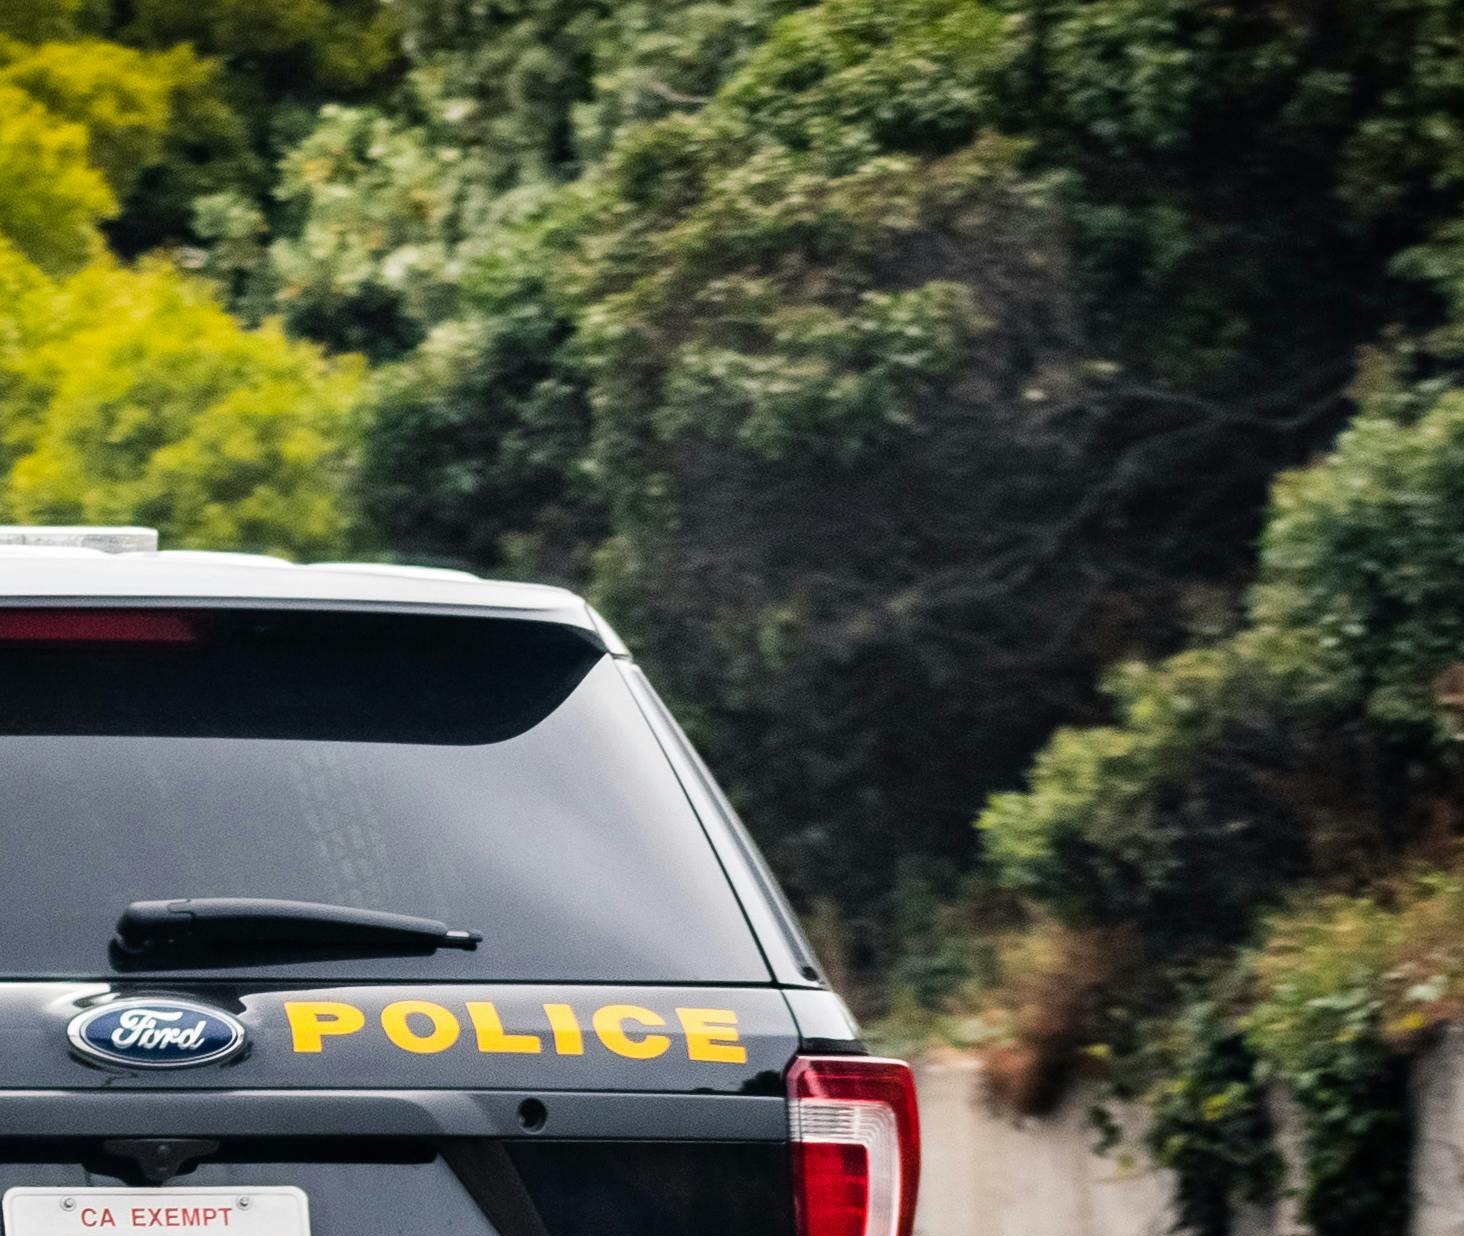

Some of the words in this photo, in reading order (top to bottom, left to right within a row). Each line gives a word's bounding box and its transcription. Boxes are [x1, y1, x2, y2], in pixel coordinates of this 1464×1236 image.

[110, 1008, 207, 1050] Ford
[283, 1000, 748, 1064] POLICE
[80, 1207, 116, 1227] CA
[131, 1207, 233, 1227] EXEMPT
